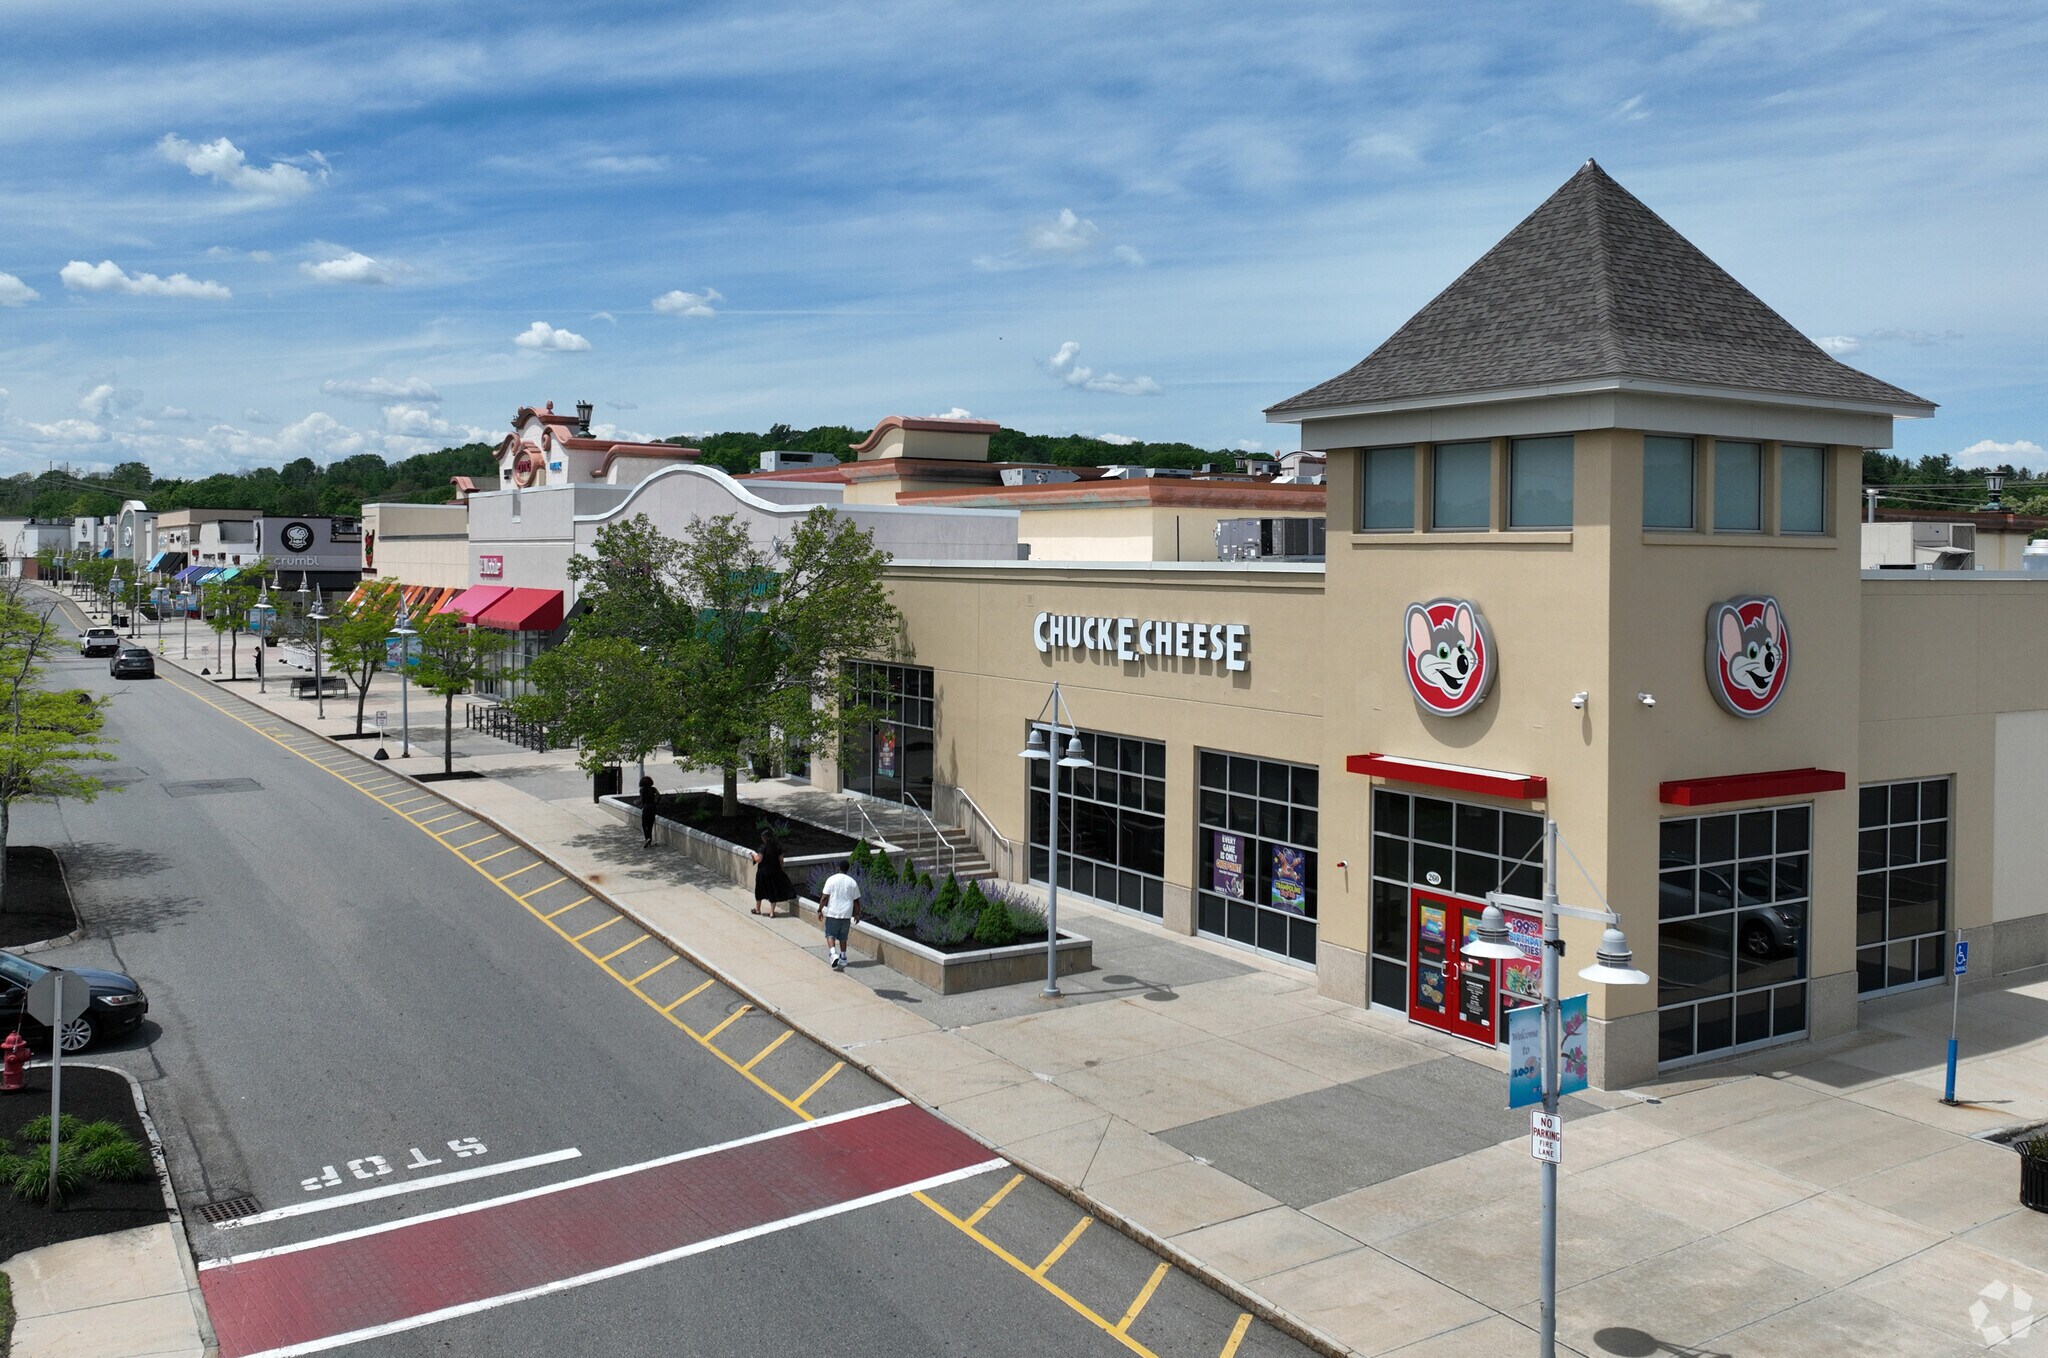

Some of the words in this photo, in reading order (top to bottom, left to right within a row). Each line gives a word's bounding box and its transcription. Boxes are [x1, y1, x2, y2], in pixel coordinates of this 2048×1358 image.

[273, 556, 320, 566] crumbl
[1033, 611, 1112, 653] CHUCK
[1139, 619, 1250, 671] CHEESE
[1222, 835, 1236, 845] EVERY
[1222, 844, 1236, 854] GAME
[1226, 853, 1238, 862] ONLY
[1428, 873, 1440, 882] 260
[1512, 1029, 1538, 1040] Welcome
[1522, 1046, 1530, 1056] to
[1540, 1117, 1553, 1129] NO
[1533, 1127, 1560, 1142] PARKING
[1539, 1139, 1554, 1149] FIRE
[1538, 1148, 1554, 1158] LANE
